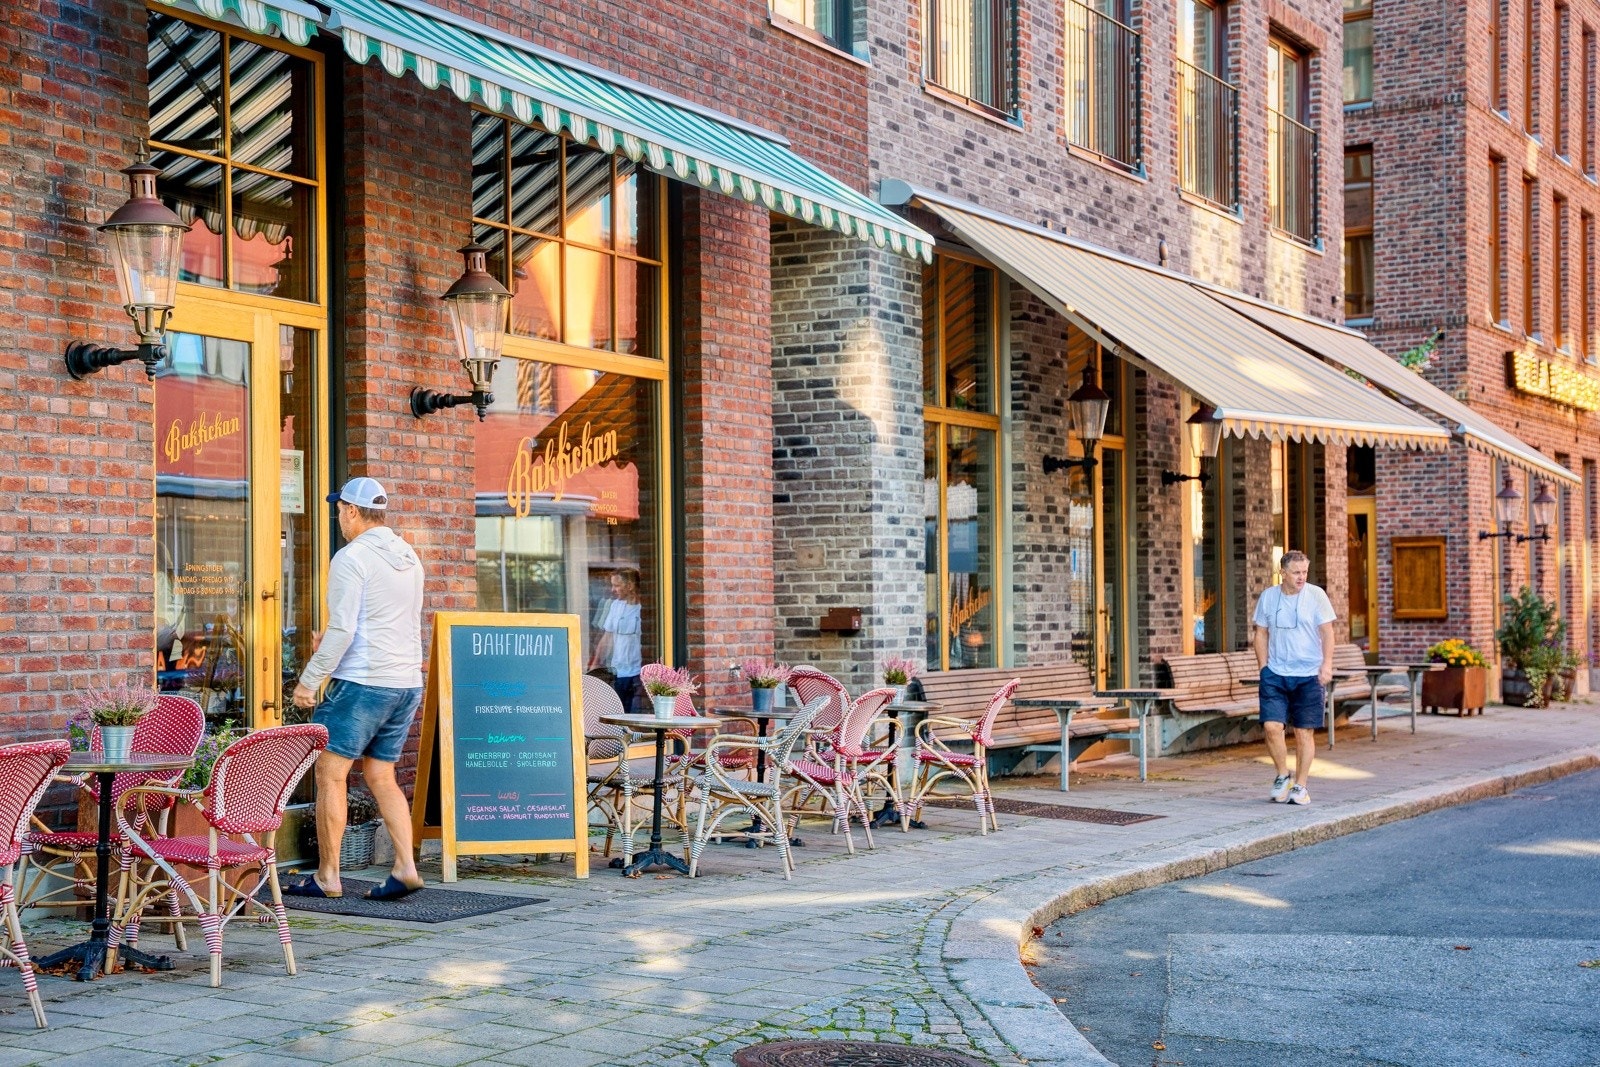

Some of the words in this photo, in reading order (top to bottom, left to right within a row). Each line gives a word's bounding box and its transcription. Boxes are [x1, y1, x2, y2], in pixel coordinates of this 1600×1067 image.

[164, 411, 240, 464] Bakfickan
[507, 421, 619, 519] Bakfickan
[201, 575, 223, 583] FREDAG
[472, 632, 554, 656] BAKFICKAN
[467, 751, 511, 760] WIENERBRØD
[518, 751, 558, 760] CROISSANT
[466, 804, 498, 813] VEGANSK
[499, 804, 521, 813] SALAT
[464, 813, 496, 821] FOCACCIA
